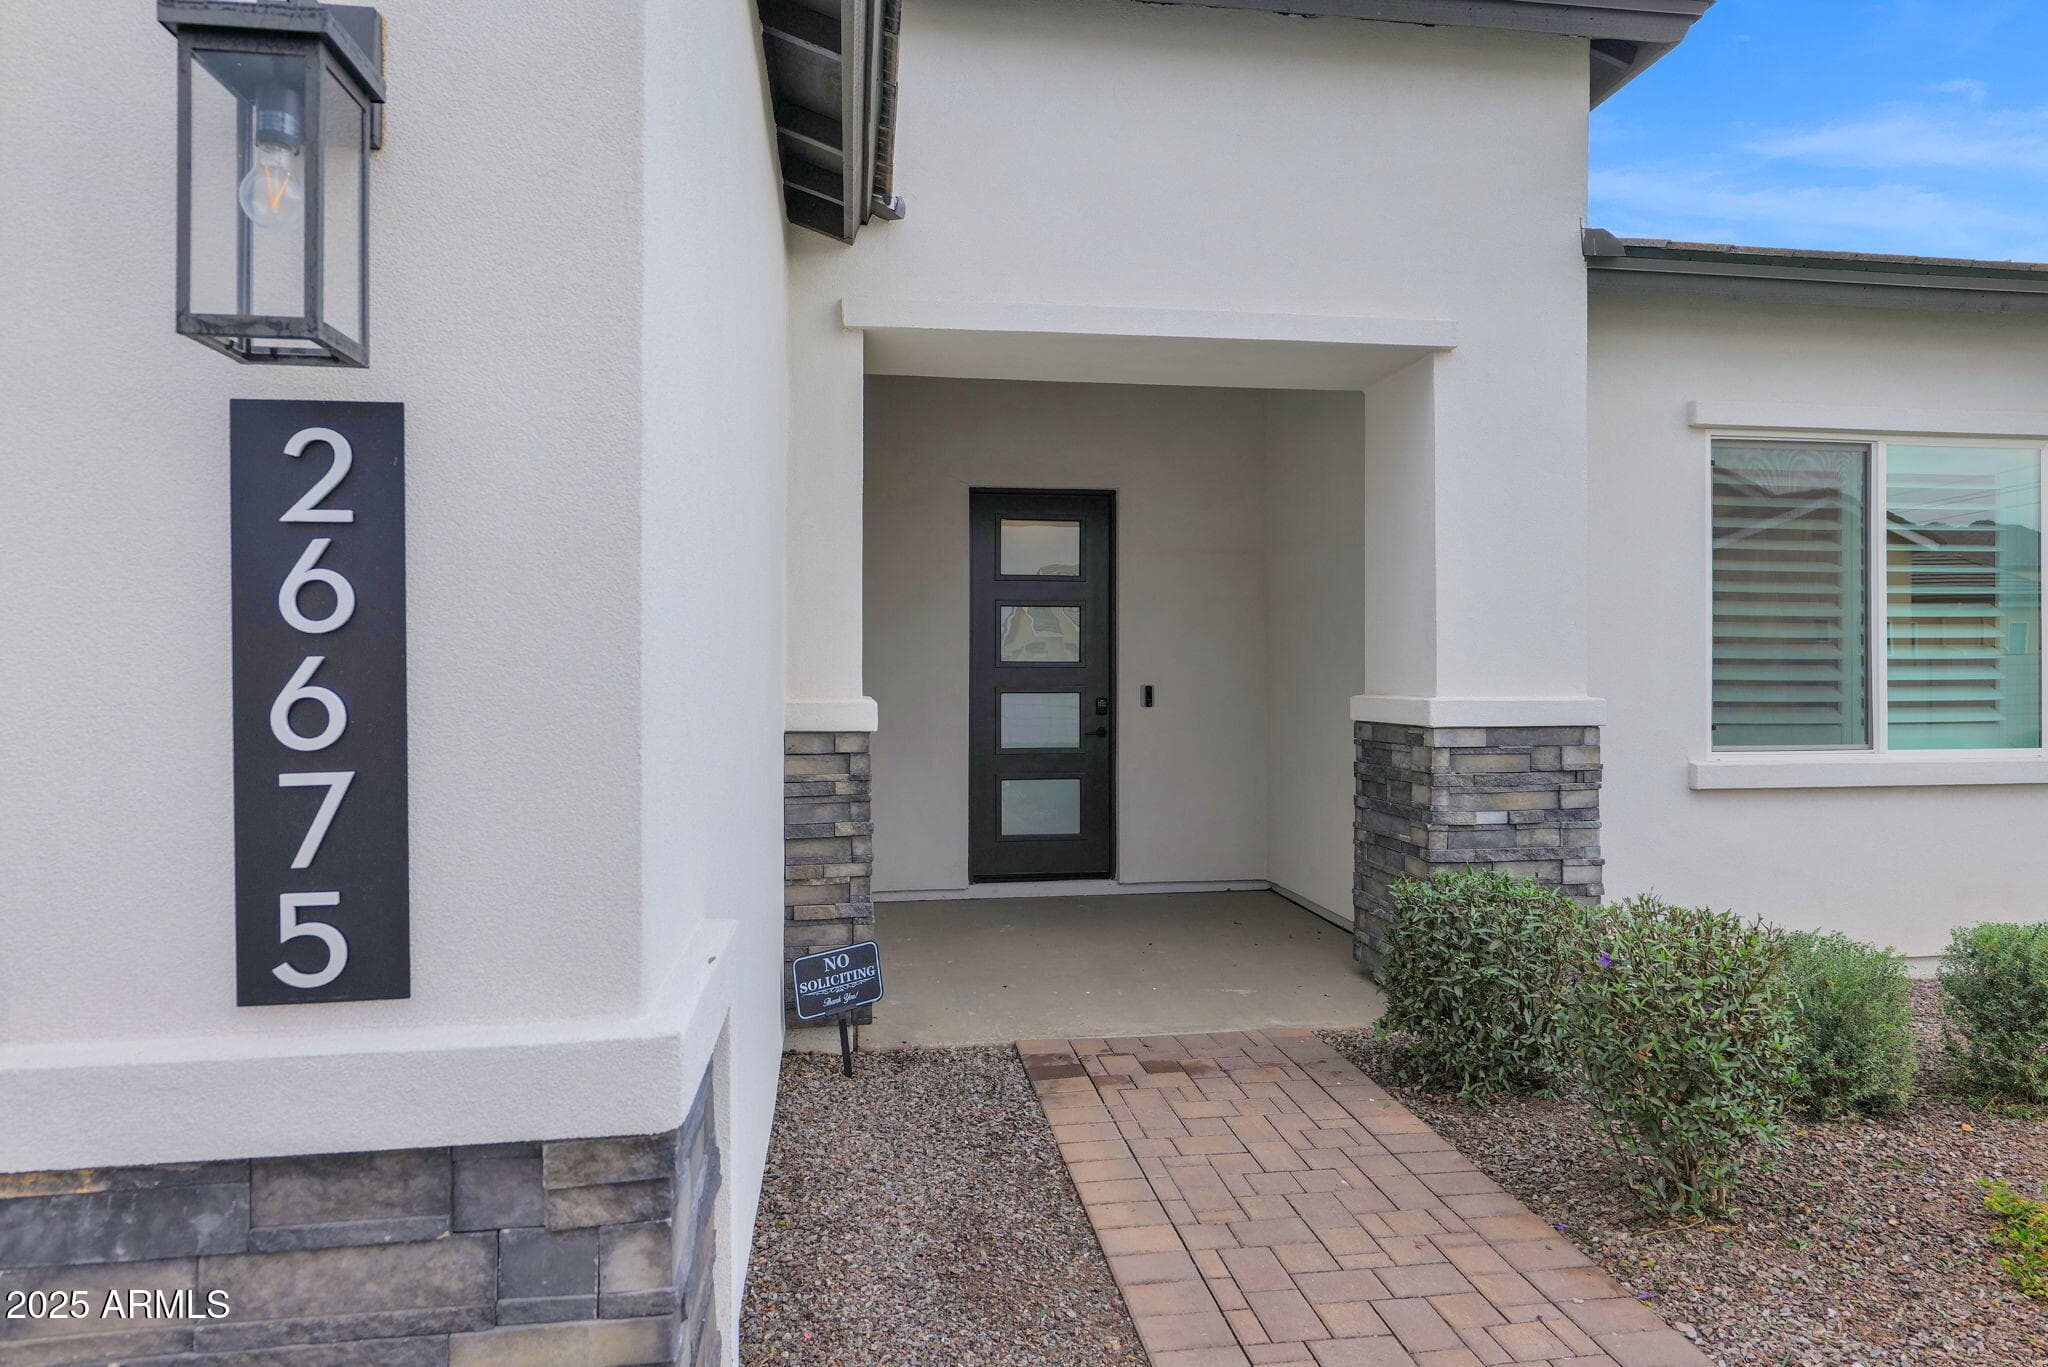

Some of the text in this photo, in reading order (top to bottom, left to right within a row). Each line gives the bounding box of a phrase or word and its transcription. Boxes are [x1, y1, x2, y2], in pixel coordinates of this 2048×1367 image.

[269, 427, 356, 989] 26675
[823, 953, 850, 972] NO
[799, 965, 876, 994] SOLICITING
